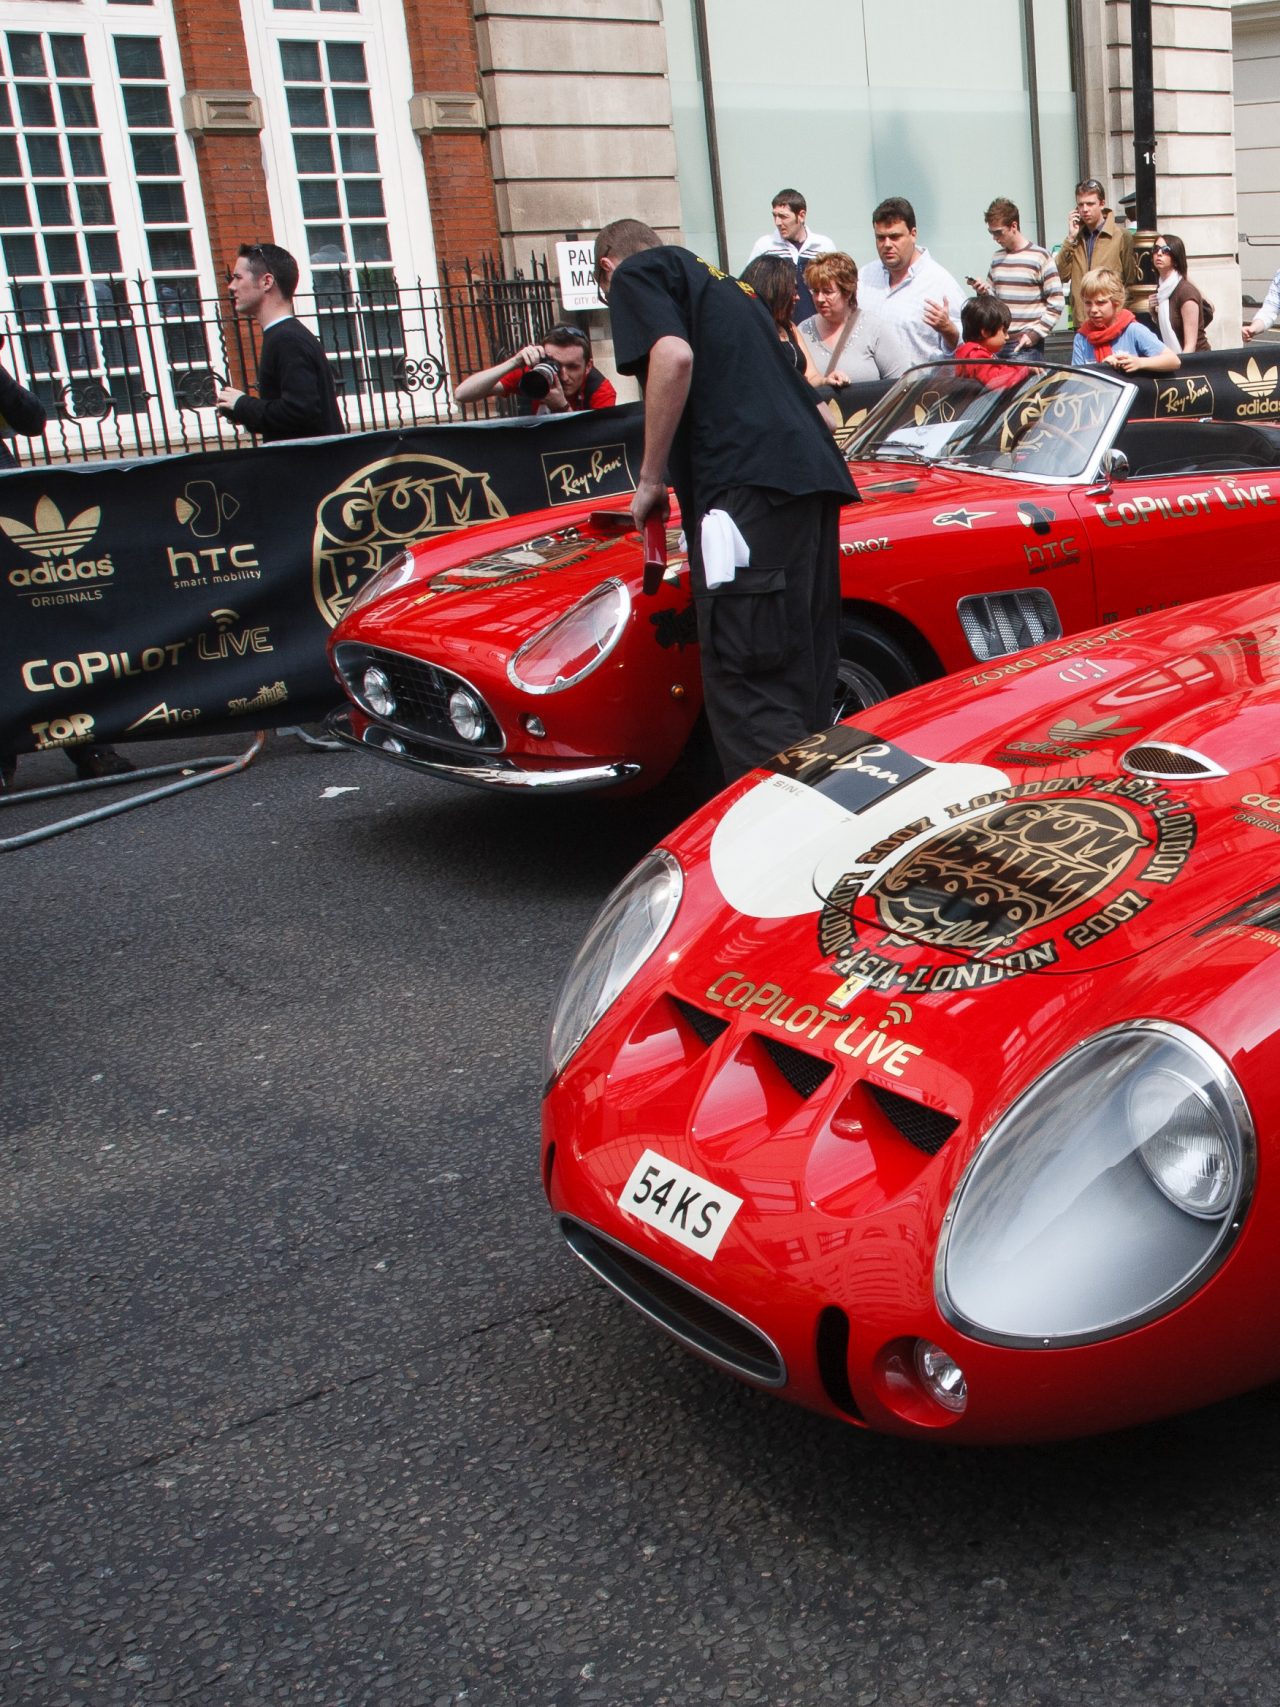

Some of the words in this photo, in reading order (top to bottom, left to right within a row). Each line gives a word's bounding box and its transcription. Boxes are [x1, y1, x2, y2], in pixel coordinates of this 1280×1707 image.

[569, 250, 595, 266] PAL
[571, 271, 596, 287] MA
[574, 297, 589, 306] CITY
[318, 472, 500, 545] GUM
[840, 537, 893, 557] DROZ
[8, 557, 115, 588] adidas
[174, 576, 207, 589] smart
[213, 568, 262, 585] mobility
[32, 589, 103, 608] ORIGINALS
[32, 713, 95, 744] TOP
[1005, 740, 1092, 759] adidas
[944, 775, 1095, 819] LONDON
[1100, 776, 1165, 807] ASIA
[855, 816, 937, 865] 2007
[1136, 800, 1199, 885] LONDON
[817, 869, 874, 959] LONDON
[1064, 890, 1152, 951] 2007
[880, 912, 1009, 960] Rally
[832, 948, 900, 993] ASIA
[907, 940, 1060, 994] LONDON
